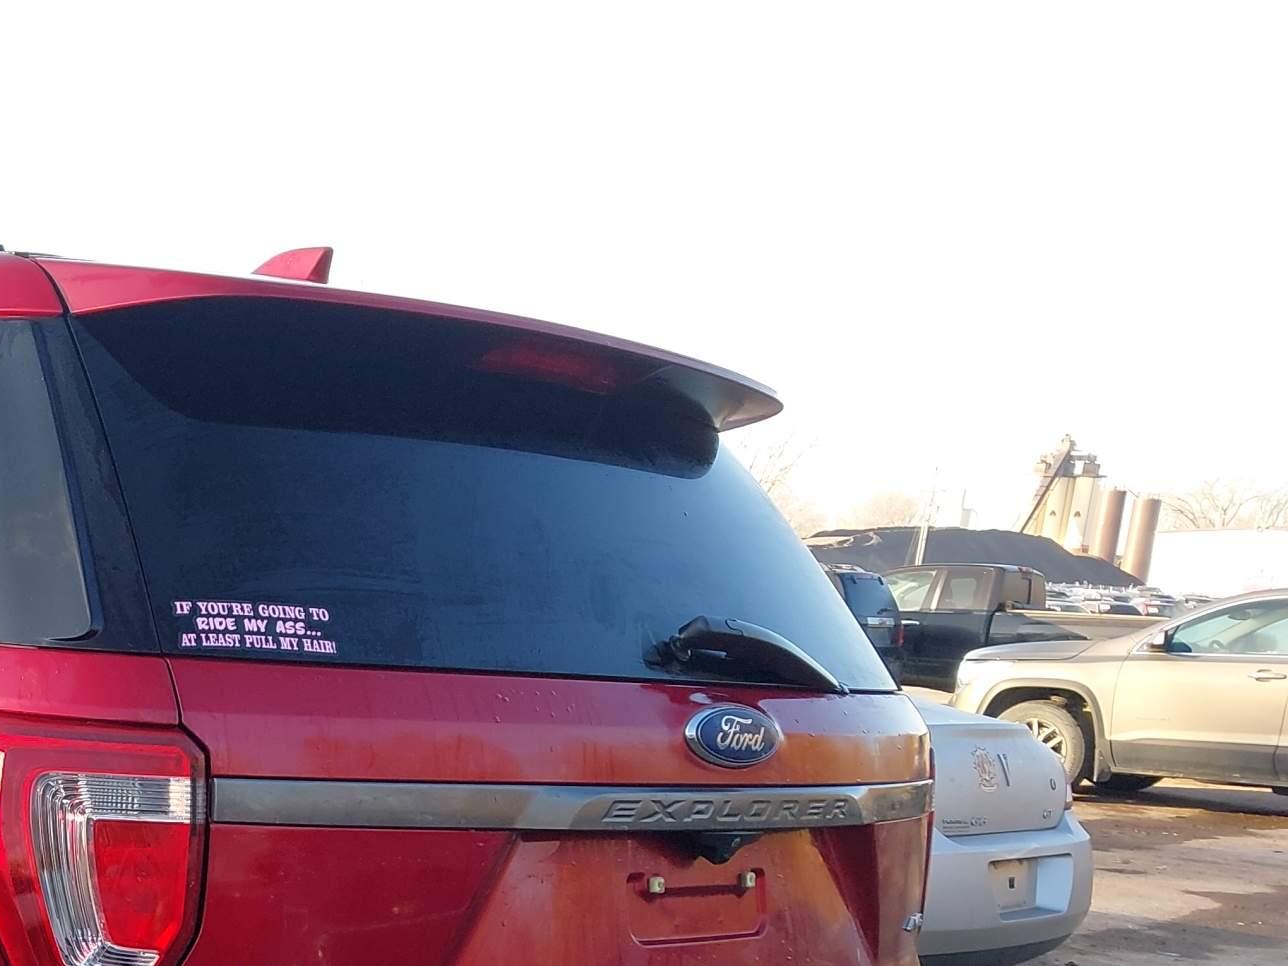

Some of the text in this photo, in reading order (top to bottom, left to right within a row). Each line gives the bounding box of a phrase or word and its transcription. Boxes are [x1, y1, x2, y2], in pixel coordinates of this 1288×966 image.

[174, 601, 330, 622] IF YOU'RE GOING TO
[196, 617, 322, 636] RIDE MY ASS...
[182, 633, 338, 654] AT LEAST PULL MY HAIR!
[716, 715, 765, 752] Ford
[601, 799, 850, 823] EXPLORER
